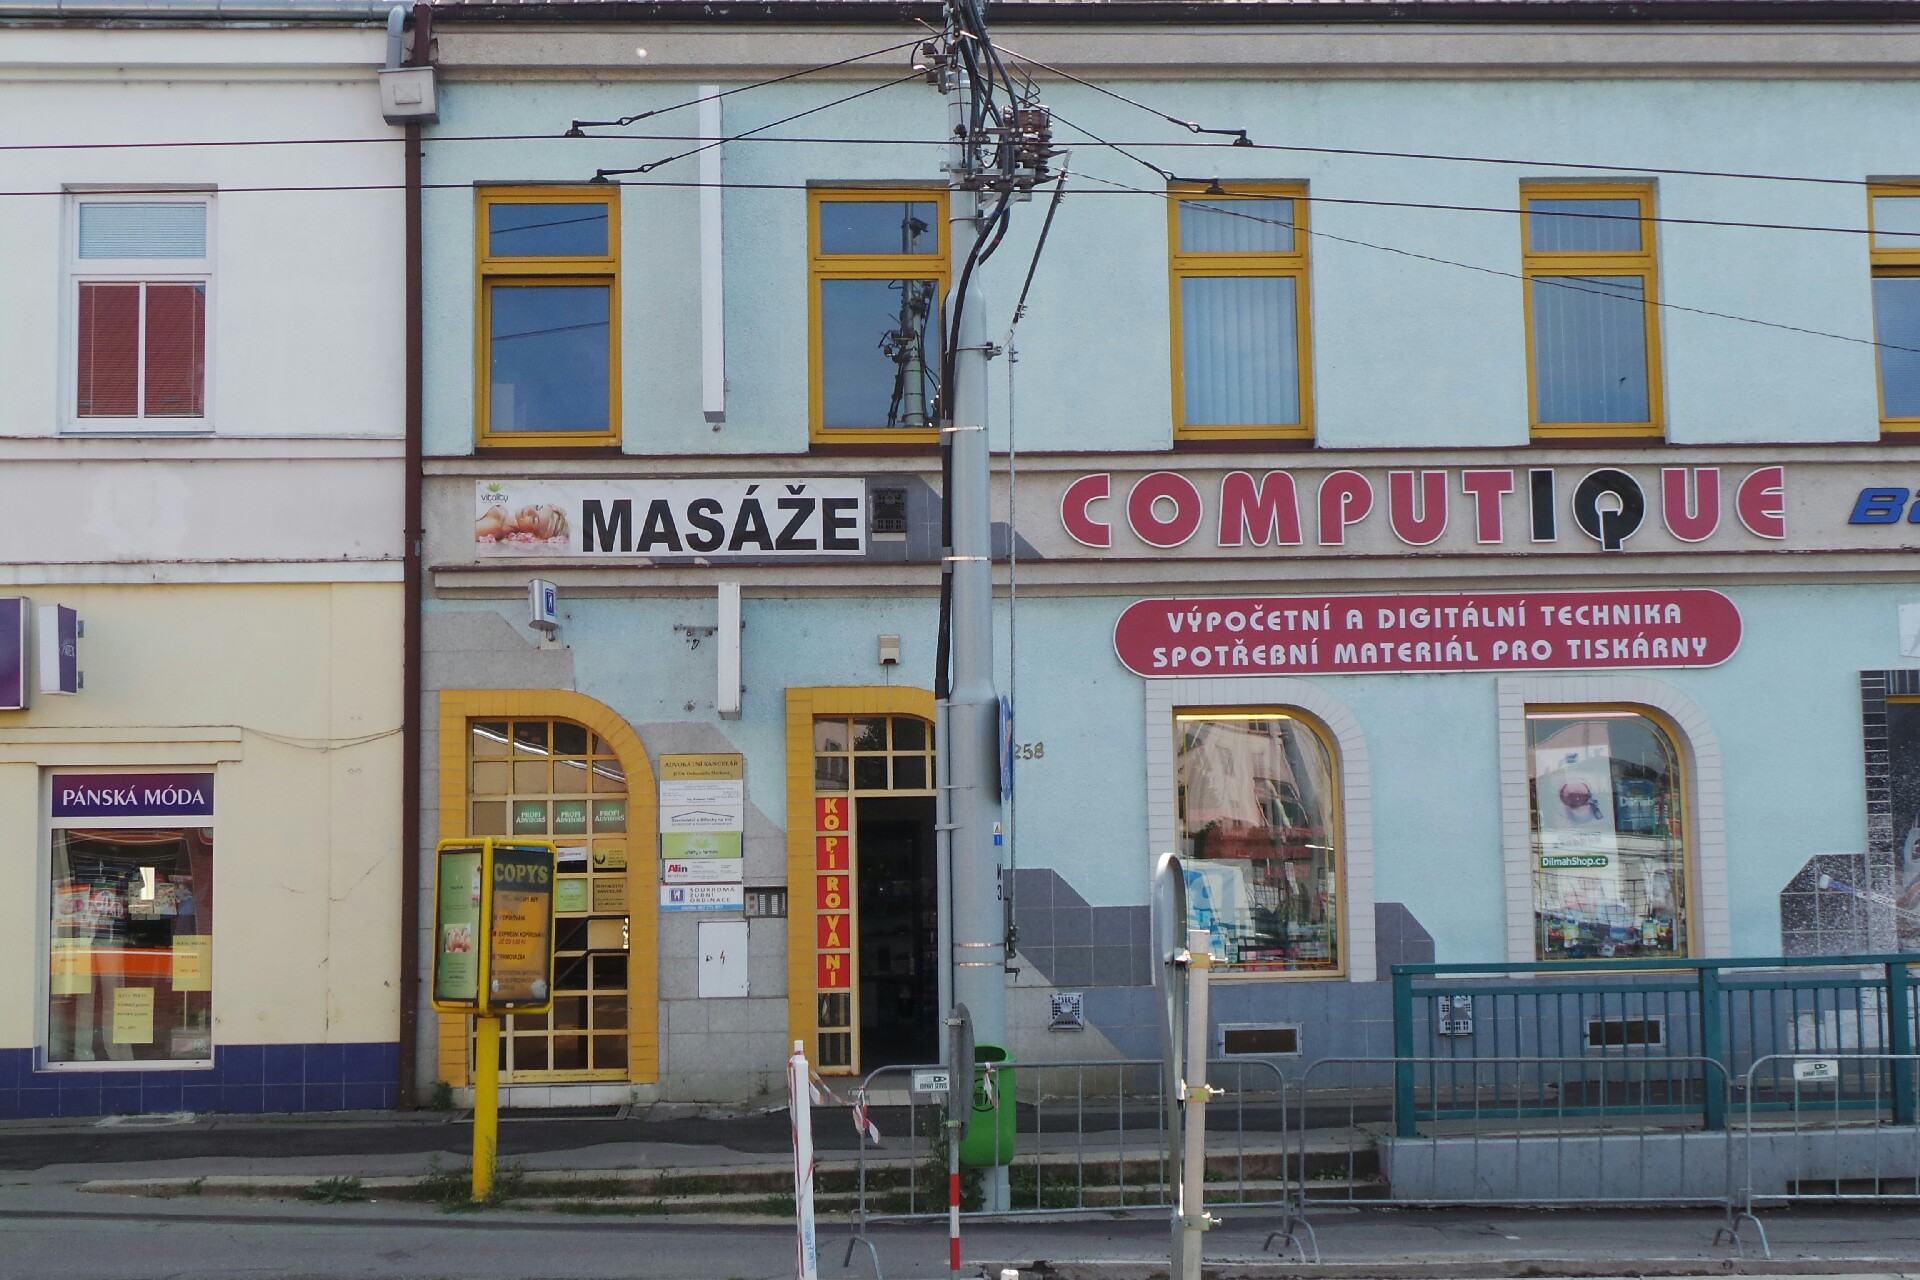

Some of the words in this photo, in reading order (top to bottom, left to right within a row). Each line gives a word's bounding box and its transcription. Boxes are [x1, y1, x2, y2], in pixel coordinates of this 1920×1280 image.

[481, 493, 509, 503] vitality
[582, 484, 860, 553] MASÁŽE
[1060, 466, 1786, 553] COMPUTIQUE
[1167, 603, 1331, 633] VÝPOČETNÍ
[1346, 609, 1363, 630] A
[1378, 600, 1526, 629] DIGITÁLNÍ
[1541, 603, 1681, 626] TECHNIKA
[1153, 638, 1318, 668] SPOTŘEBNÍ
[1334, 634, 1479, 664] MATERIÁL
[1493, 640, 1552, 660] PRO
[1567, 632, 1707, 659] TISKÁRNY
[1014, 741, 1045, 760] 258
[62, 785, 138, 806] PÁNSKÁ
[144, 784, 205, 805] MÓDA
[668, 864, 688, 873] Alin
[1542, 856, 1606, 867] DilmahShop.cz
[494, 863, 549, 884] COPYS
[824, 798, 841, 987] KOPÍROVÁNÍ
